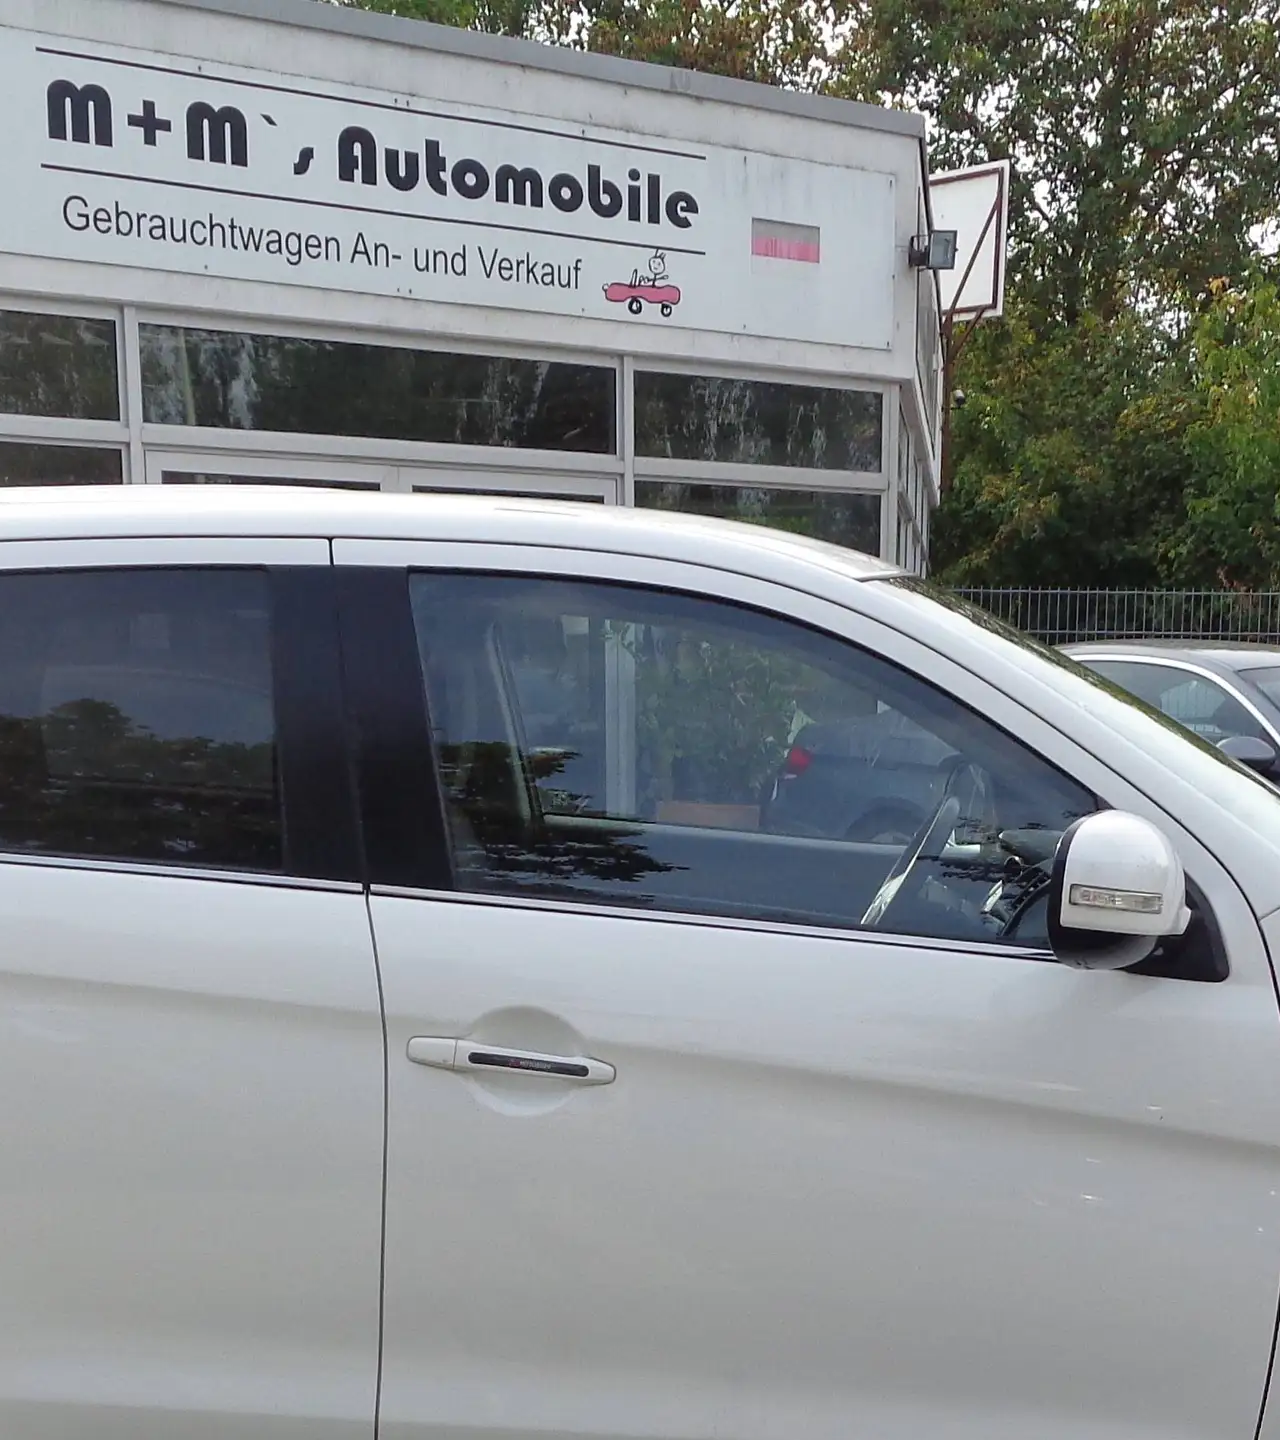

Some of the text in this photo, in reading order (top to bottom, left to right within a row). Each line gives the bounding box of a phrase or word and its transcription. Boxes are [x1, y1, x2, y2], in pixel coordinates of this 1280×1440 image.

[337, 126, 699, 229] Automobile
[62, 195, 582, 290] Gebrauchtwagen An- und Verkauf
